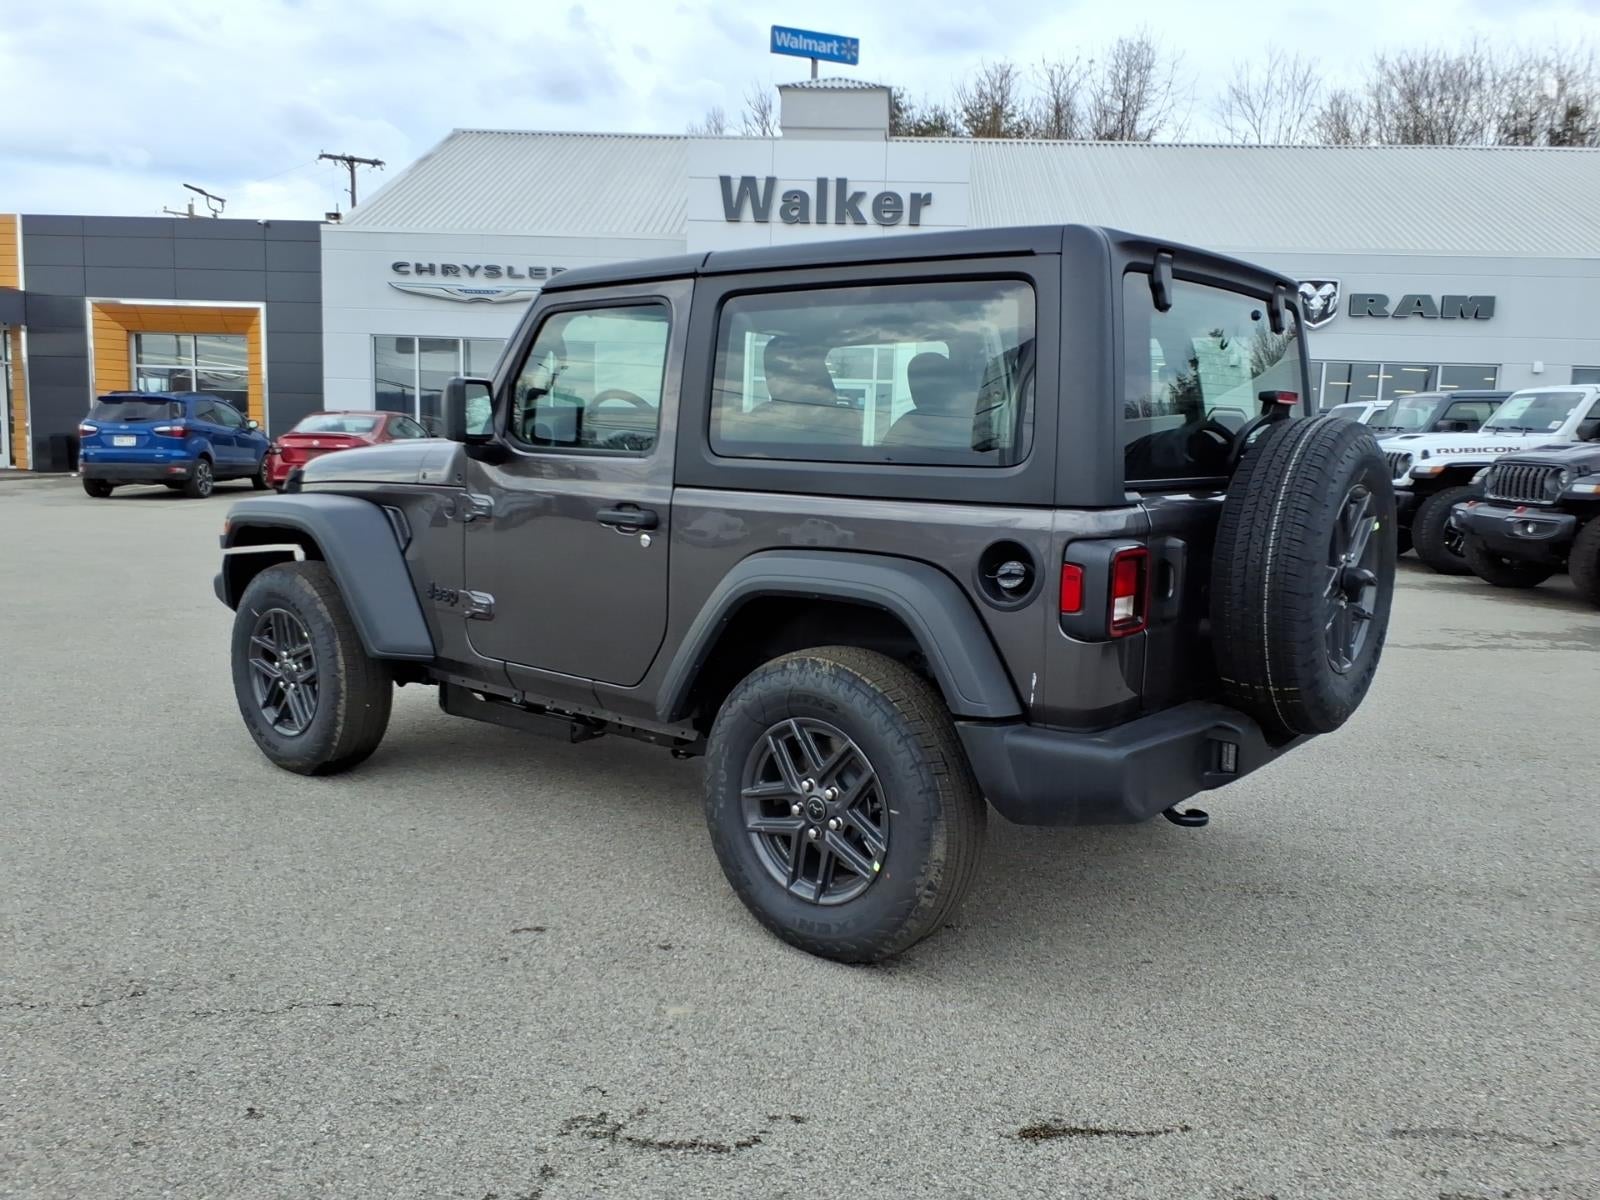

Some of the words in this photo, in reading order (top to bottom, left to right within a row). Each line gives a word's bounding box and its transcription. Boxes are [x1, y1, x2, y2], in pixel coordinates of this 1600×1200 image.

[775, 30, 839, 55] Walmart
[719, 175, 932, 226] Walker
[1349, 293, 1496, 319] RAM
[1436, 446, 1520, 454] RUBICON
[427, 581, 459, 607] Jeep
